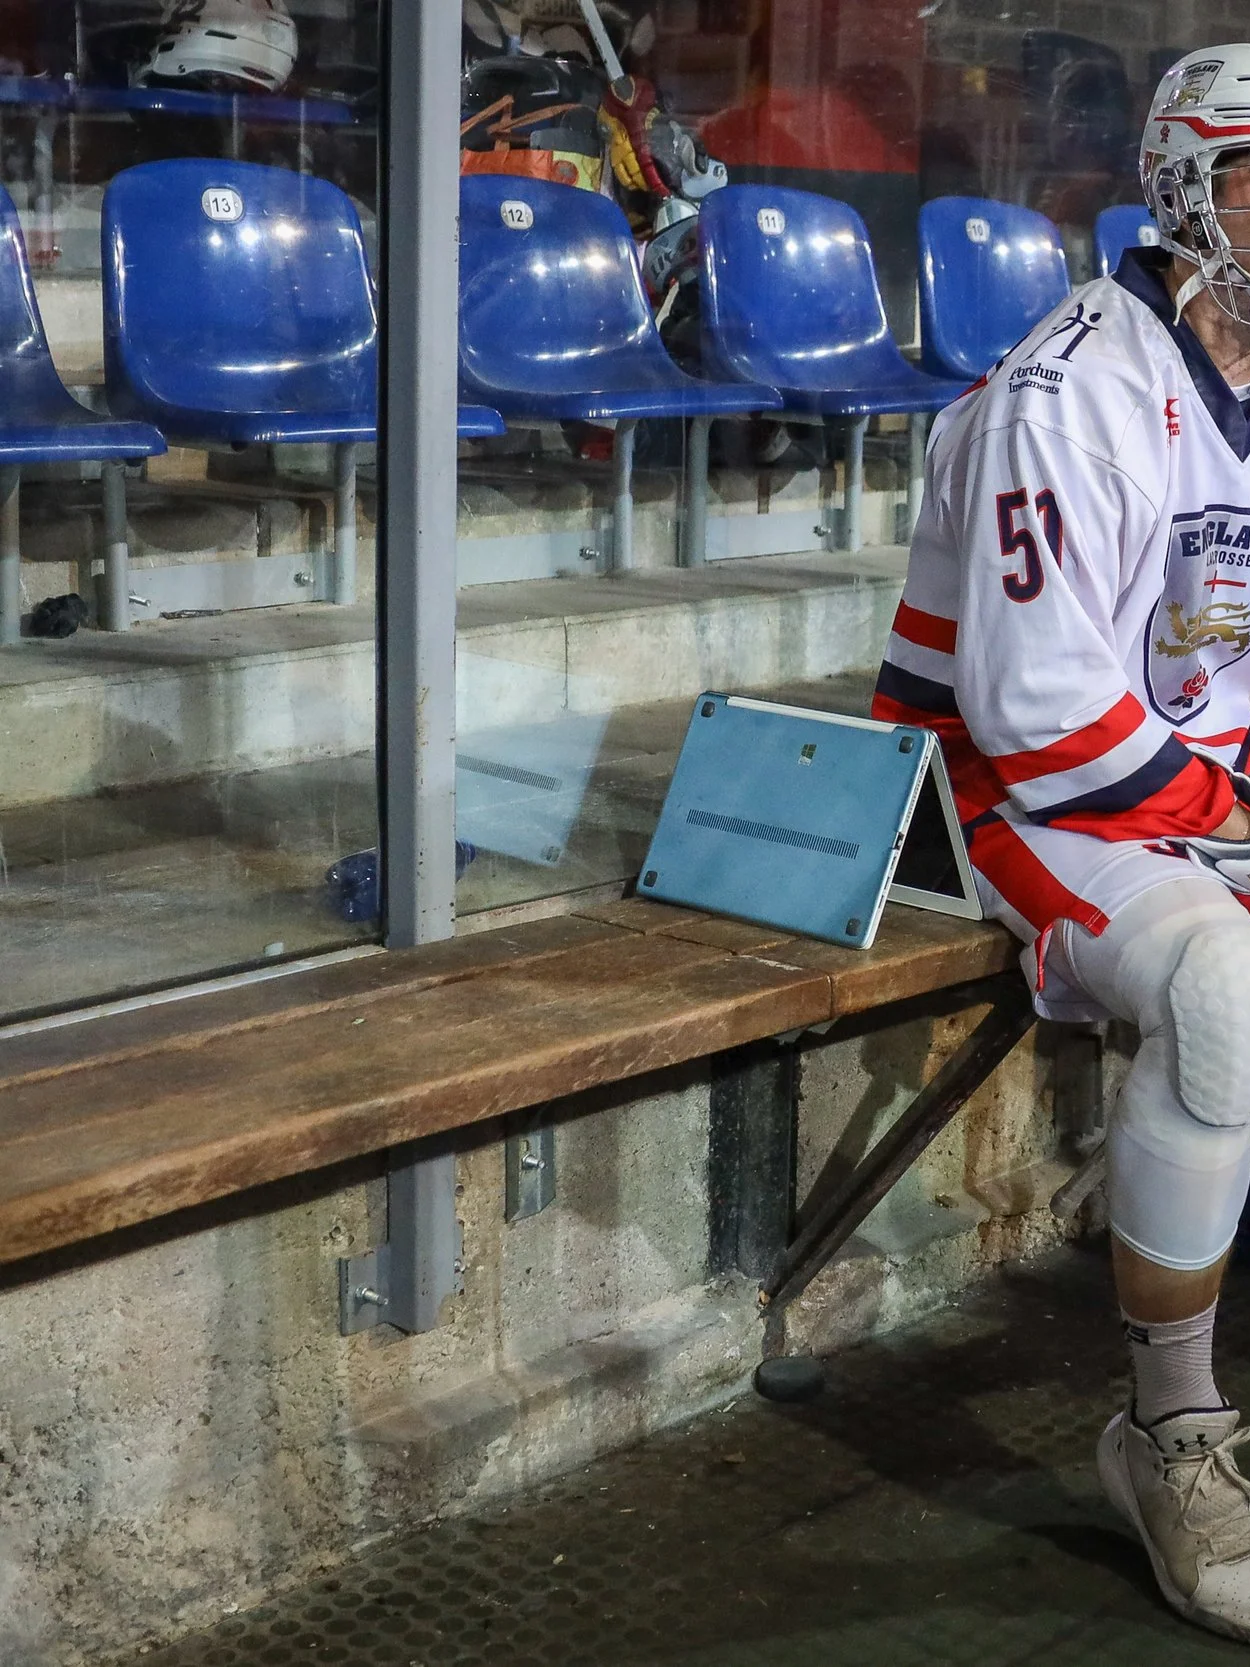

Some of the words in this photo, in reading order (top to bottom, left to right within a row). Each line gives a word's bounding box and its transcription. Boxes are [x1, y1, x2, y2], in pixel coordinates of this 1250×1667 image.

[211, 197, 231, 213] 13
[508, 208, 525, 223] 12
[764, 215, 777, 228] 11
